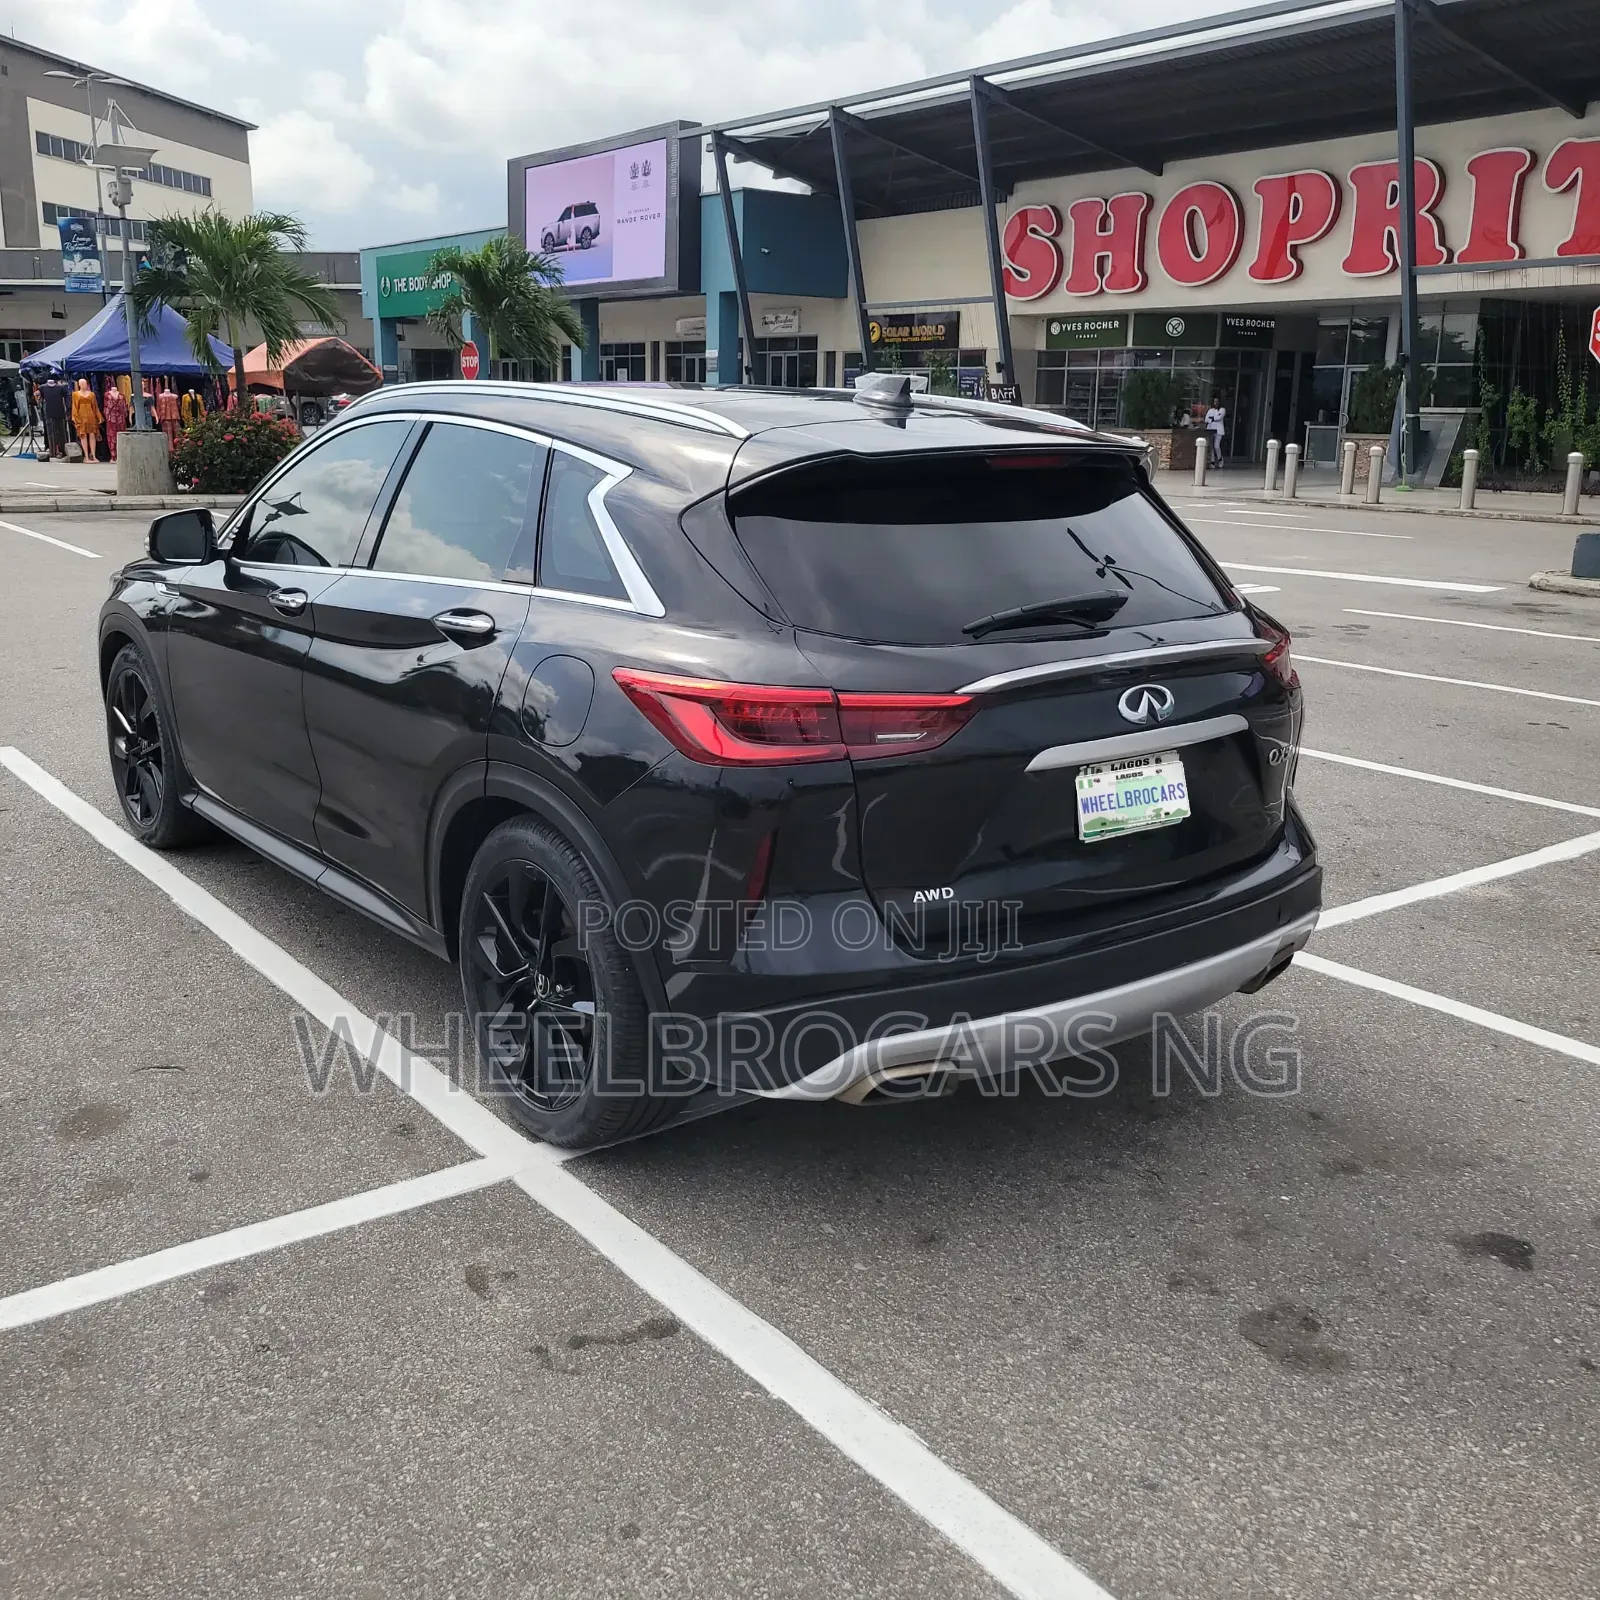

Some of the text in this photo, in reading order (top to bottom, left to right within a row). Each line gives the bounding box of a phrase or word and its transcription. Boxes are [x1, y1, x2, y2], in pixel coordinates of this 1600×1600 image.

[394, 272, 452, 292] THE BODY SHOP
[1061, 320, 1120, 331] YVES ROCHER
[1226, 318, 1276, 328] YVES ROCHER
[882, 325, 946, 337] SOLAR WORLD
[462, 356, 478, 368] STOP
[1110, 757, 1150, 772] LAGOS
[1115, 771, 1144, 781] LAGOS
[1080, 782, 1186, 815] WHEELBROCARS
[913, 886, 954, 903] AWD
